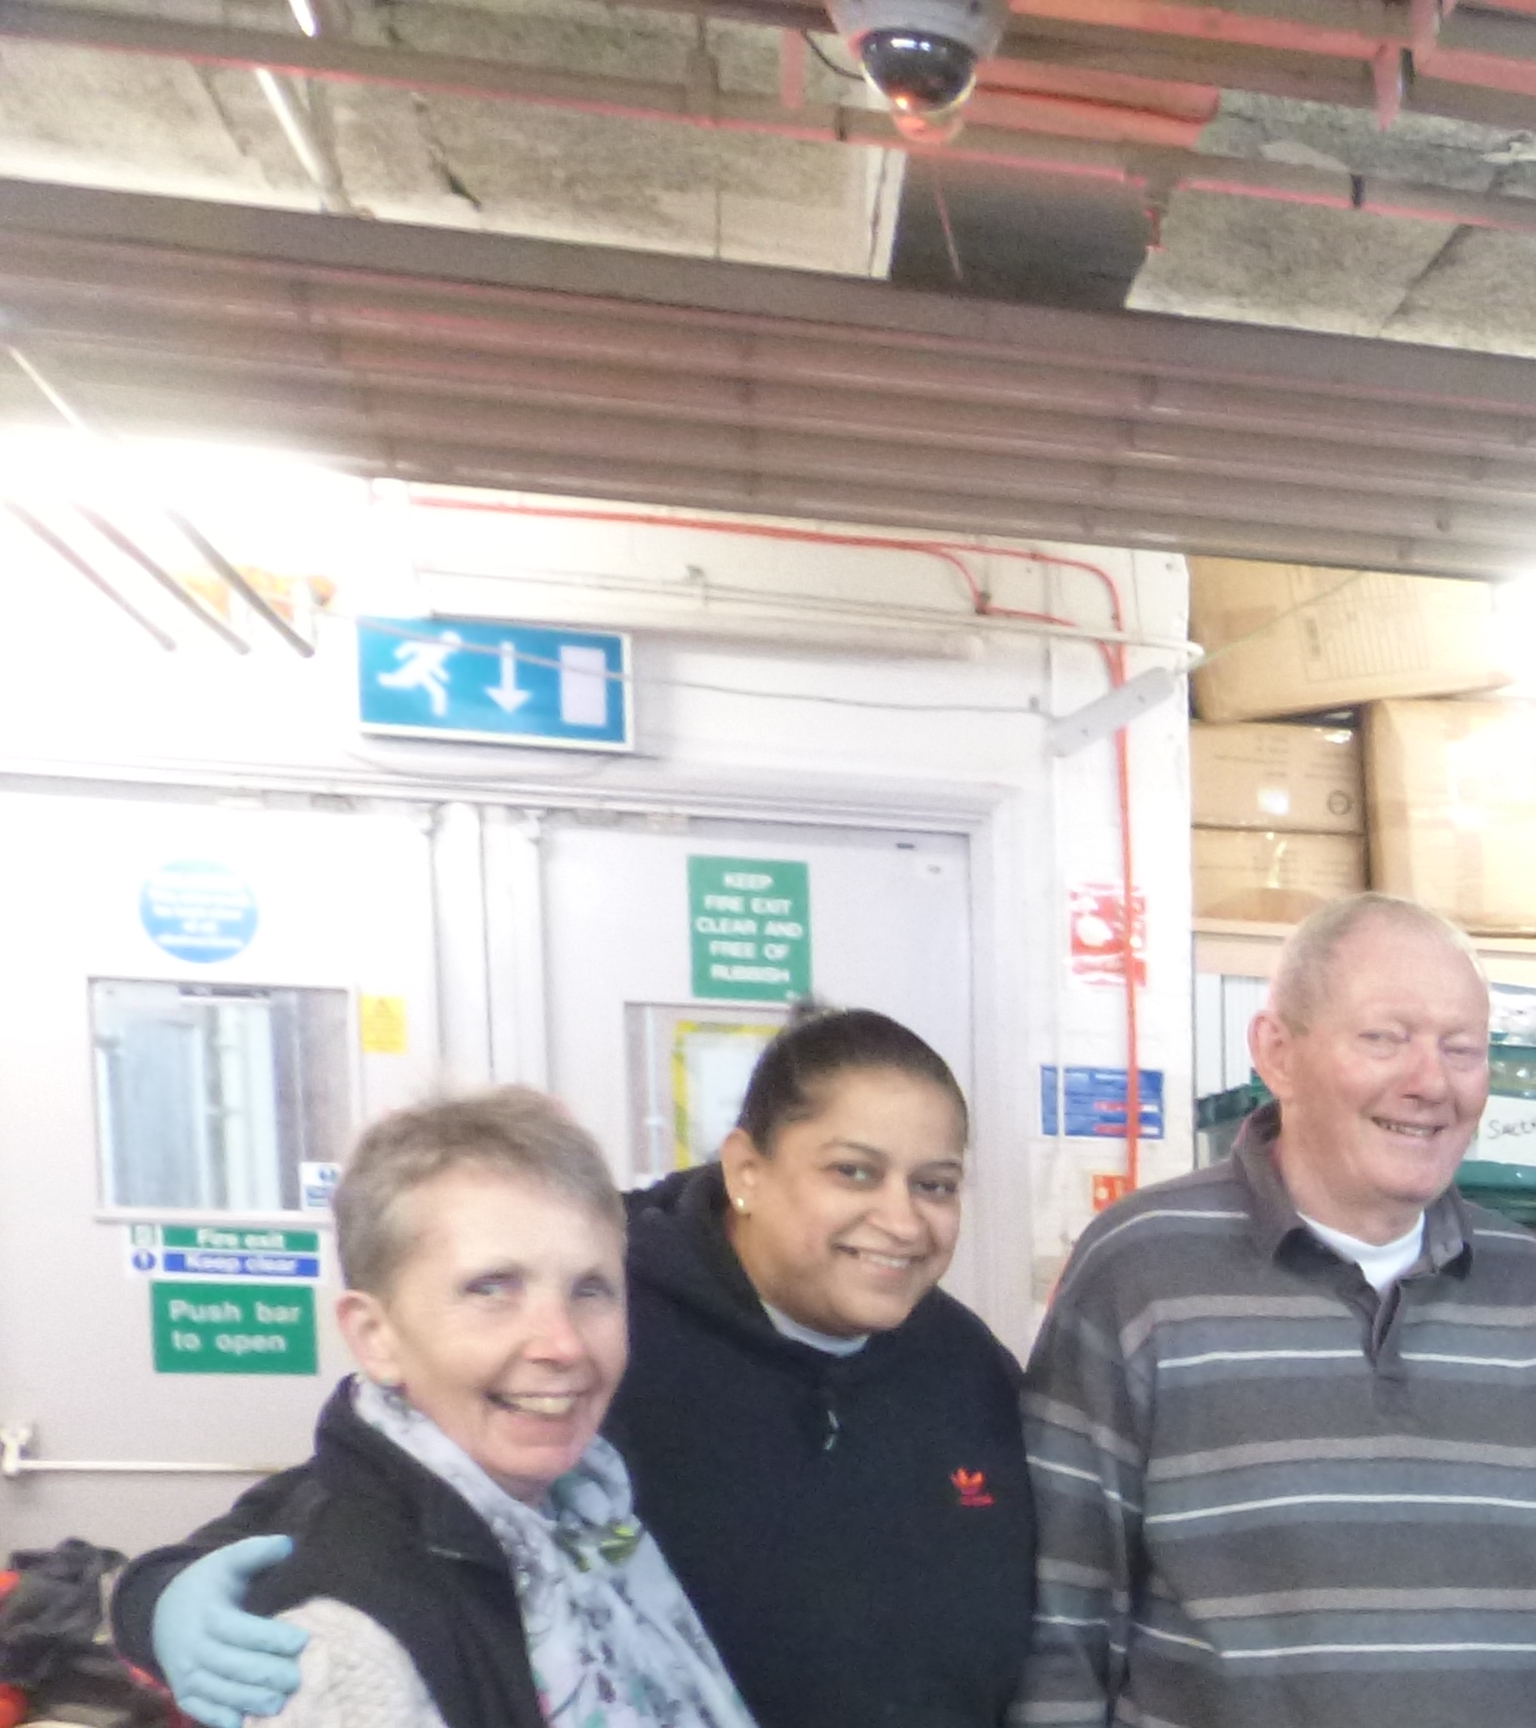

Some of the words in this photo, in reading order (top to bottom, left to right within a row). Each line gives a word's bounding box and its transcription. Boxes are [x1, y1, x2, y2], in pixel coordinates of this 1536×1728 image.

[724, 871, 774, 891] KEEP
[704, 893, 745, 914] FIRE
[751, 896, 793, 917] EXIT
[695, 915, 758, 936] CLEAR
[764, 919, 803, 939] AND
[709, 939, 756, 959] FREE
[763, 942, 791, 961] OF
[169, 1299, 242, 1323] Push
[255, 1301, 300, 1324] bar
[171, 1330, 202, 1351] to
[214, 1333, 287, 1356] open
